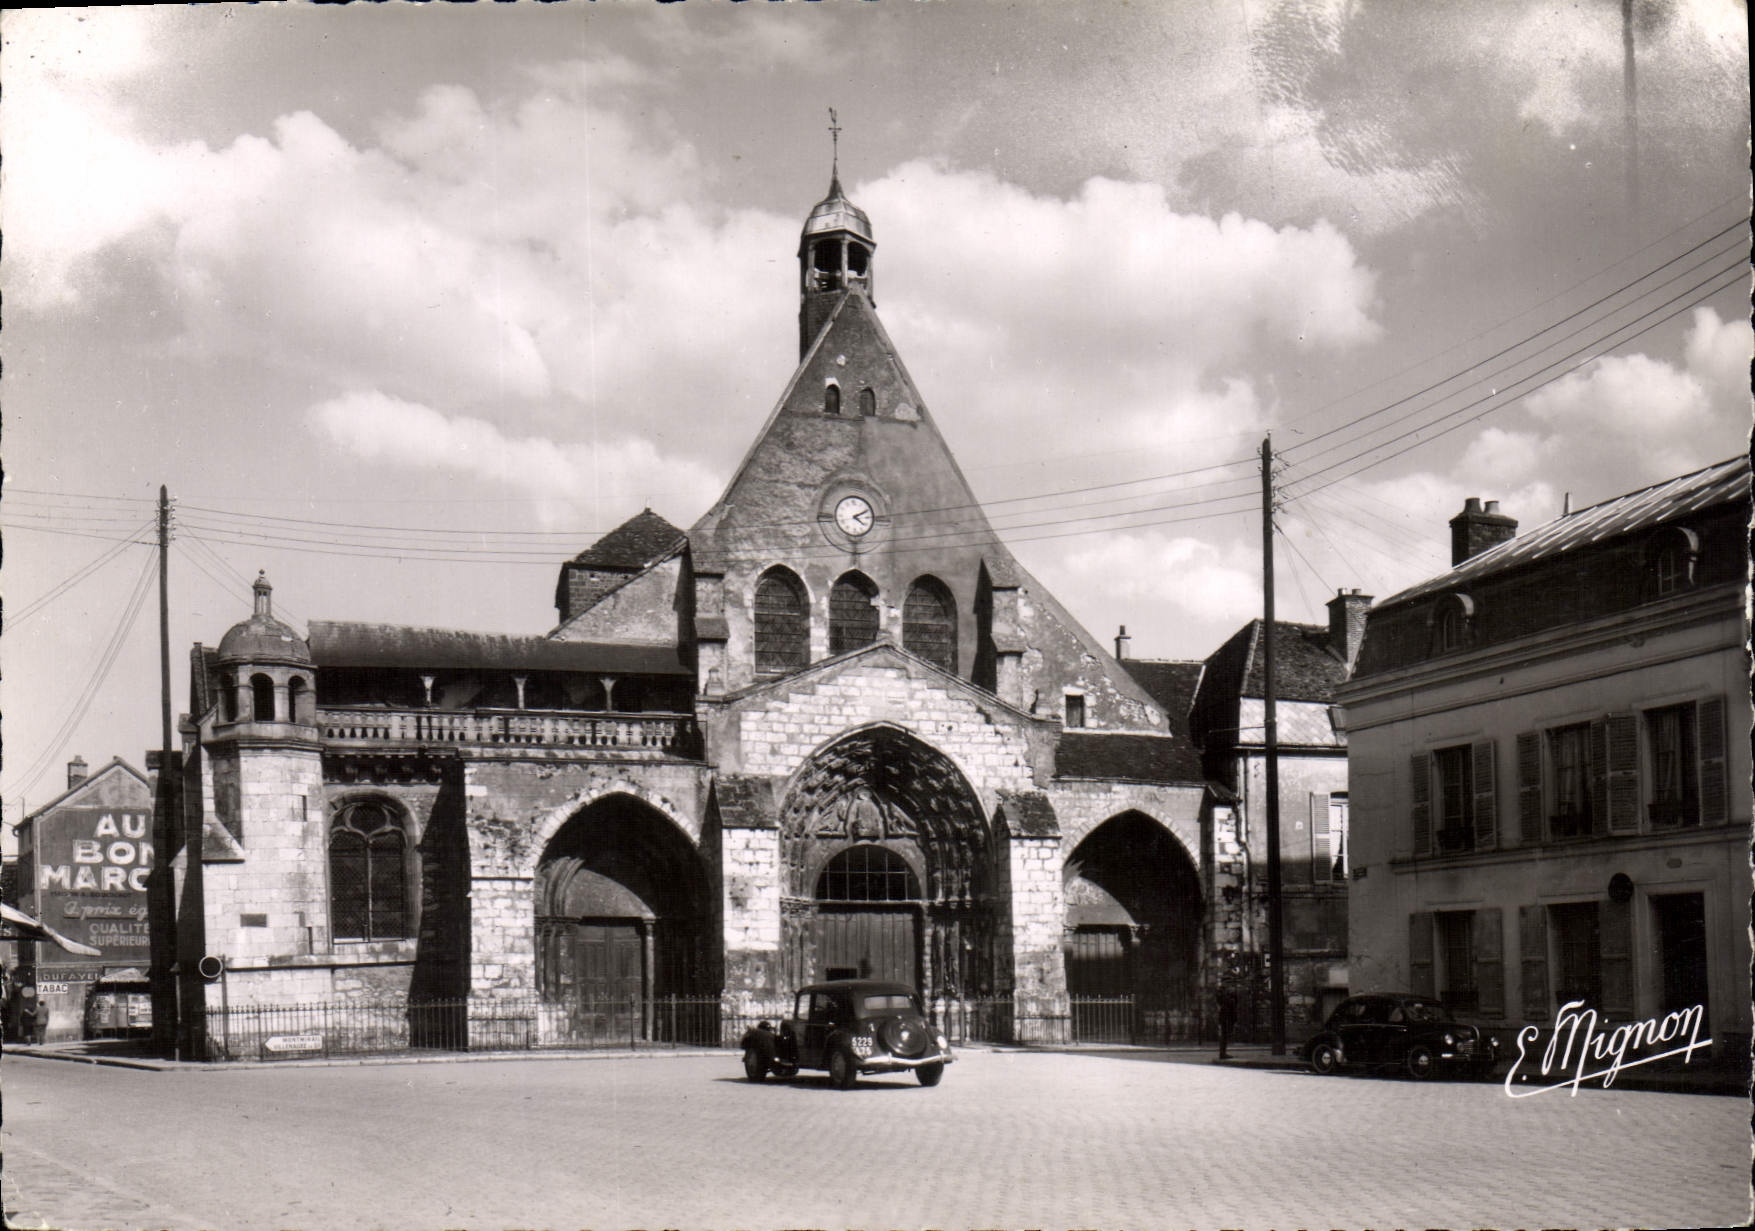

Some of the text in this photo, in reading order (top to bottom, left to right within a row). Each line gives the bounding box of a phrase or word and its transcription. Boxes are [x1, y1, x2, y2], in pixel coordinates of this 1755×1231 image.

[93, 814, 146, 839] AU
[40, 865, 152, 892] MARC
[79, 902, 122, 920] prix
[128, 903, 148, 921] ég
[89, 935, 151, 947] SUPÉRIEUR
[37, 983, 68, 993] TABAC
